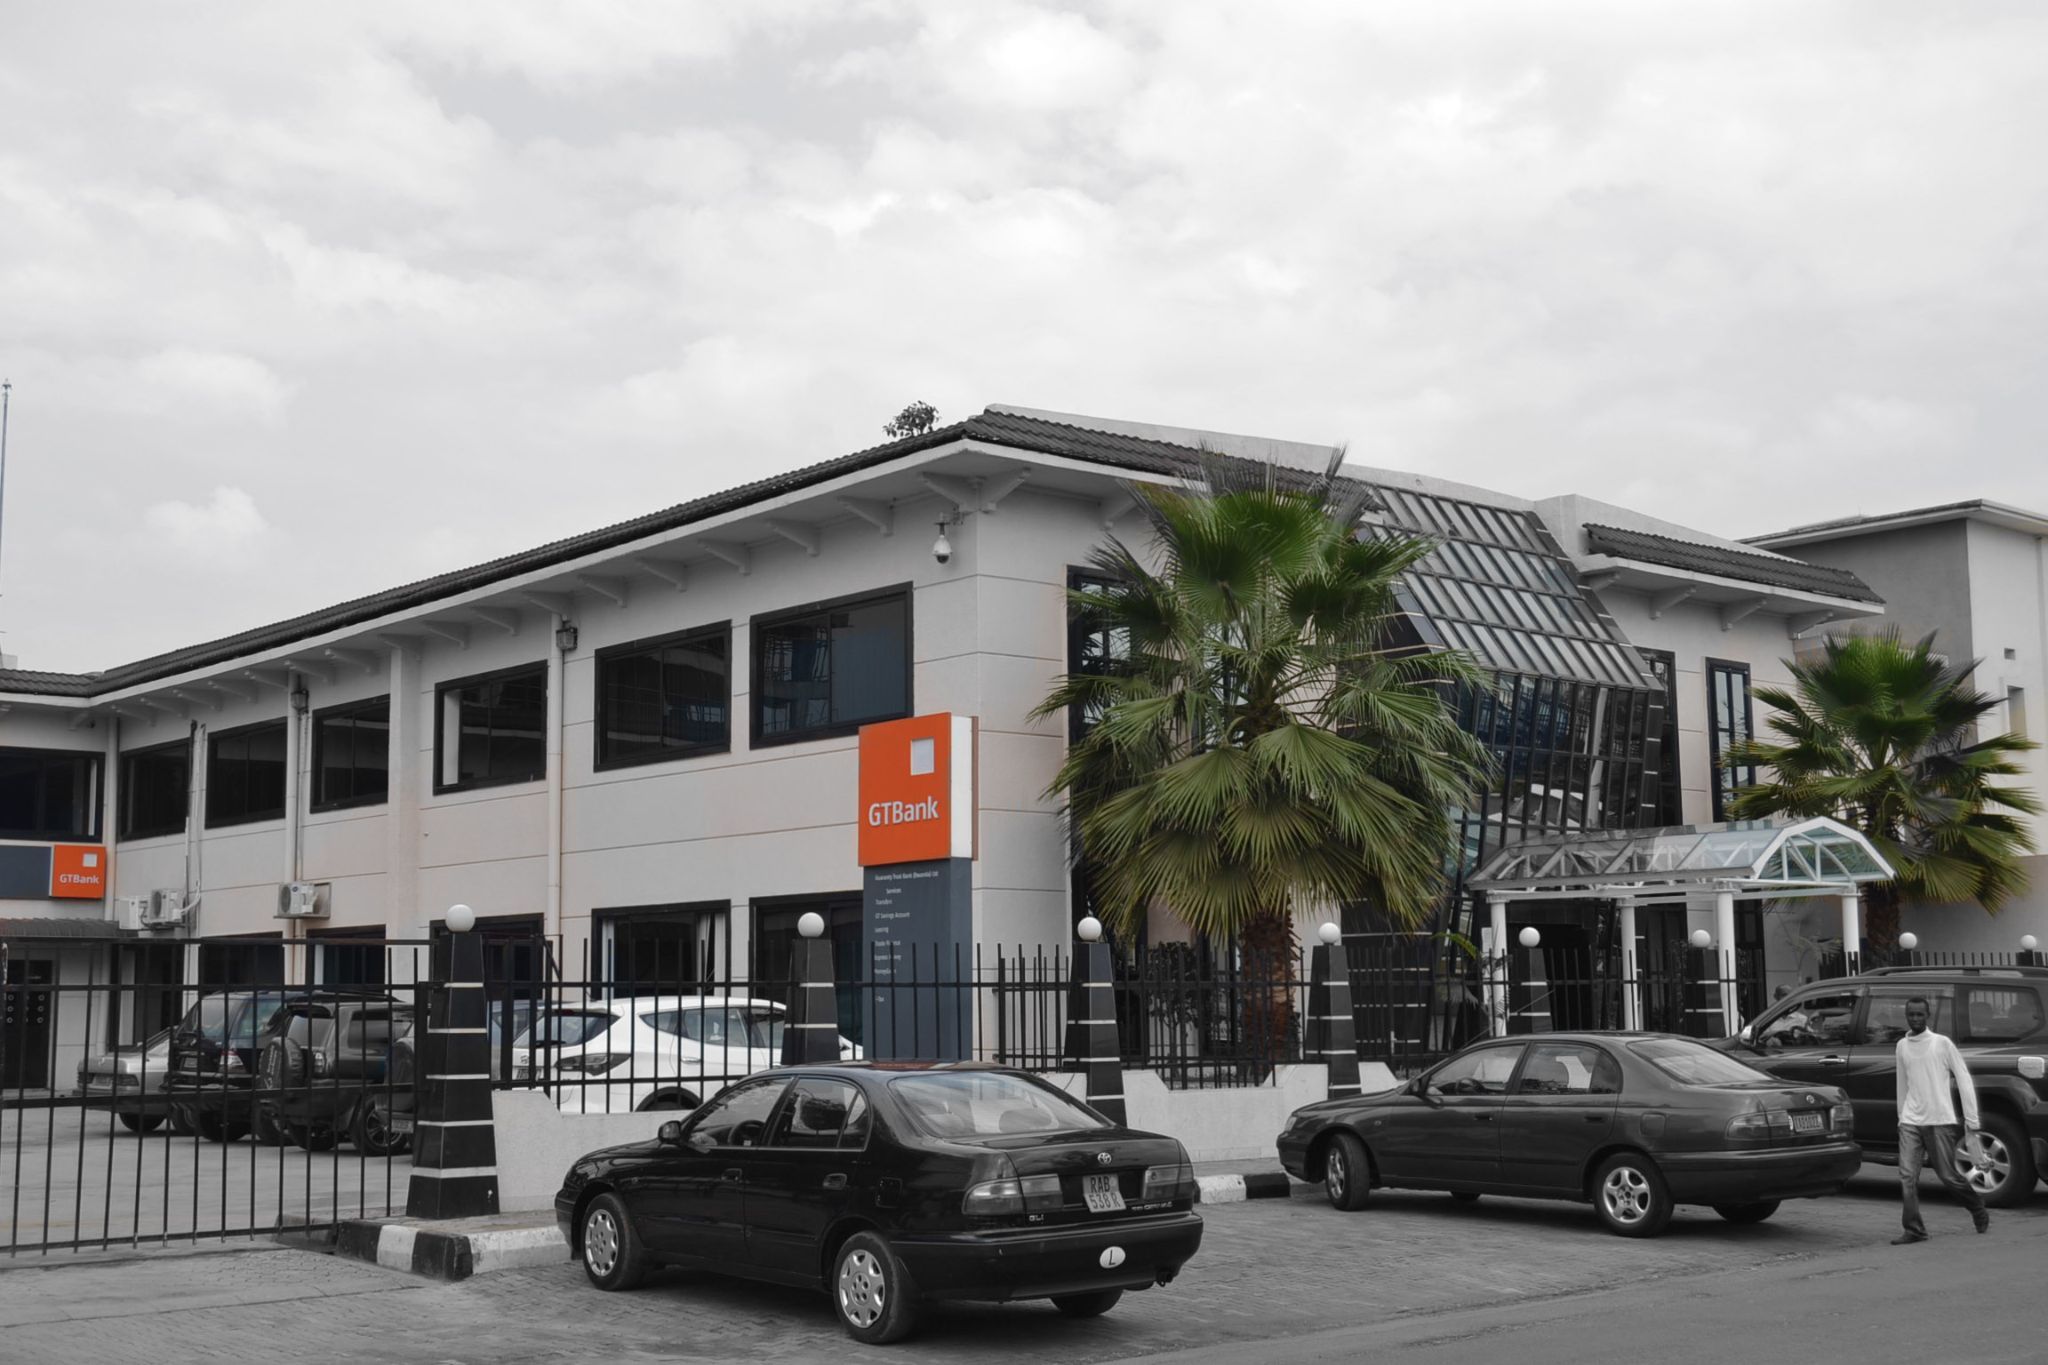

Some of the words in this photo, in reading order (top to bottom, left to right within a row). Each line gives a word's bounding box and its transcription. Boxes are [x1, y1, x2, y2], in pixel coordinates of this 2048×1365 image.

[868, 795, 939, 826] GTBank
[60, 873, 99, 884] GTBank
[1090, 1176, 1110, 1193] RAB
[1089, 1193, 1111, 1209] 538
[1111, 1192, 1121, 1208] R
[1109, 1250, 1116, 1265] L
